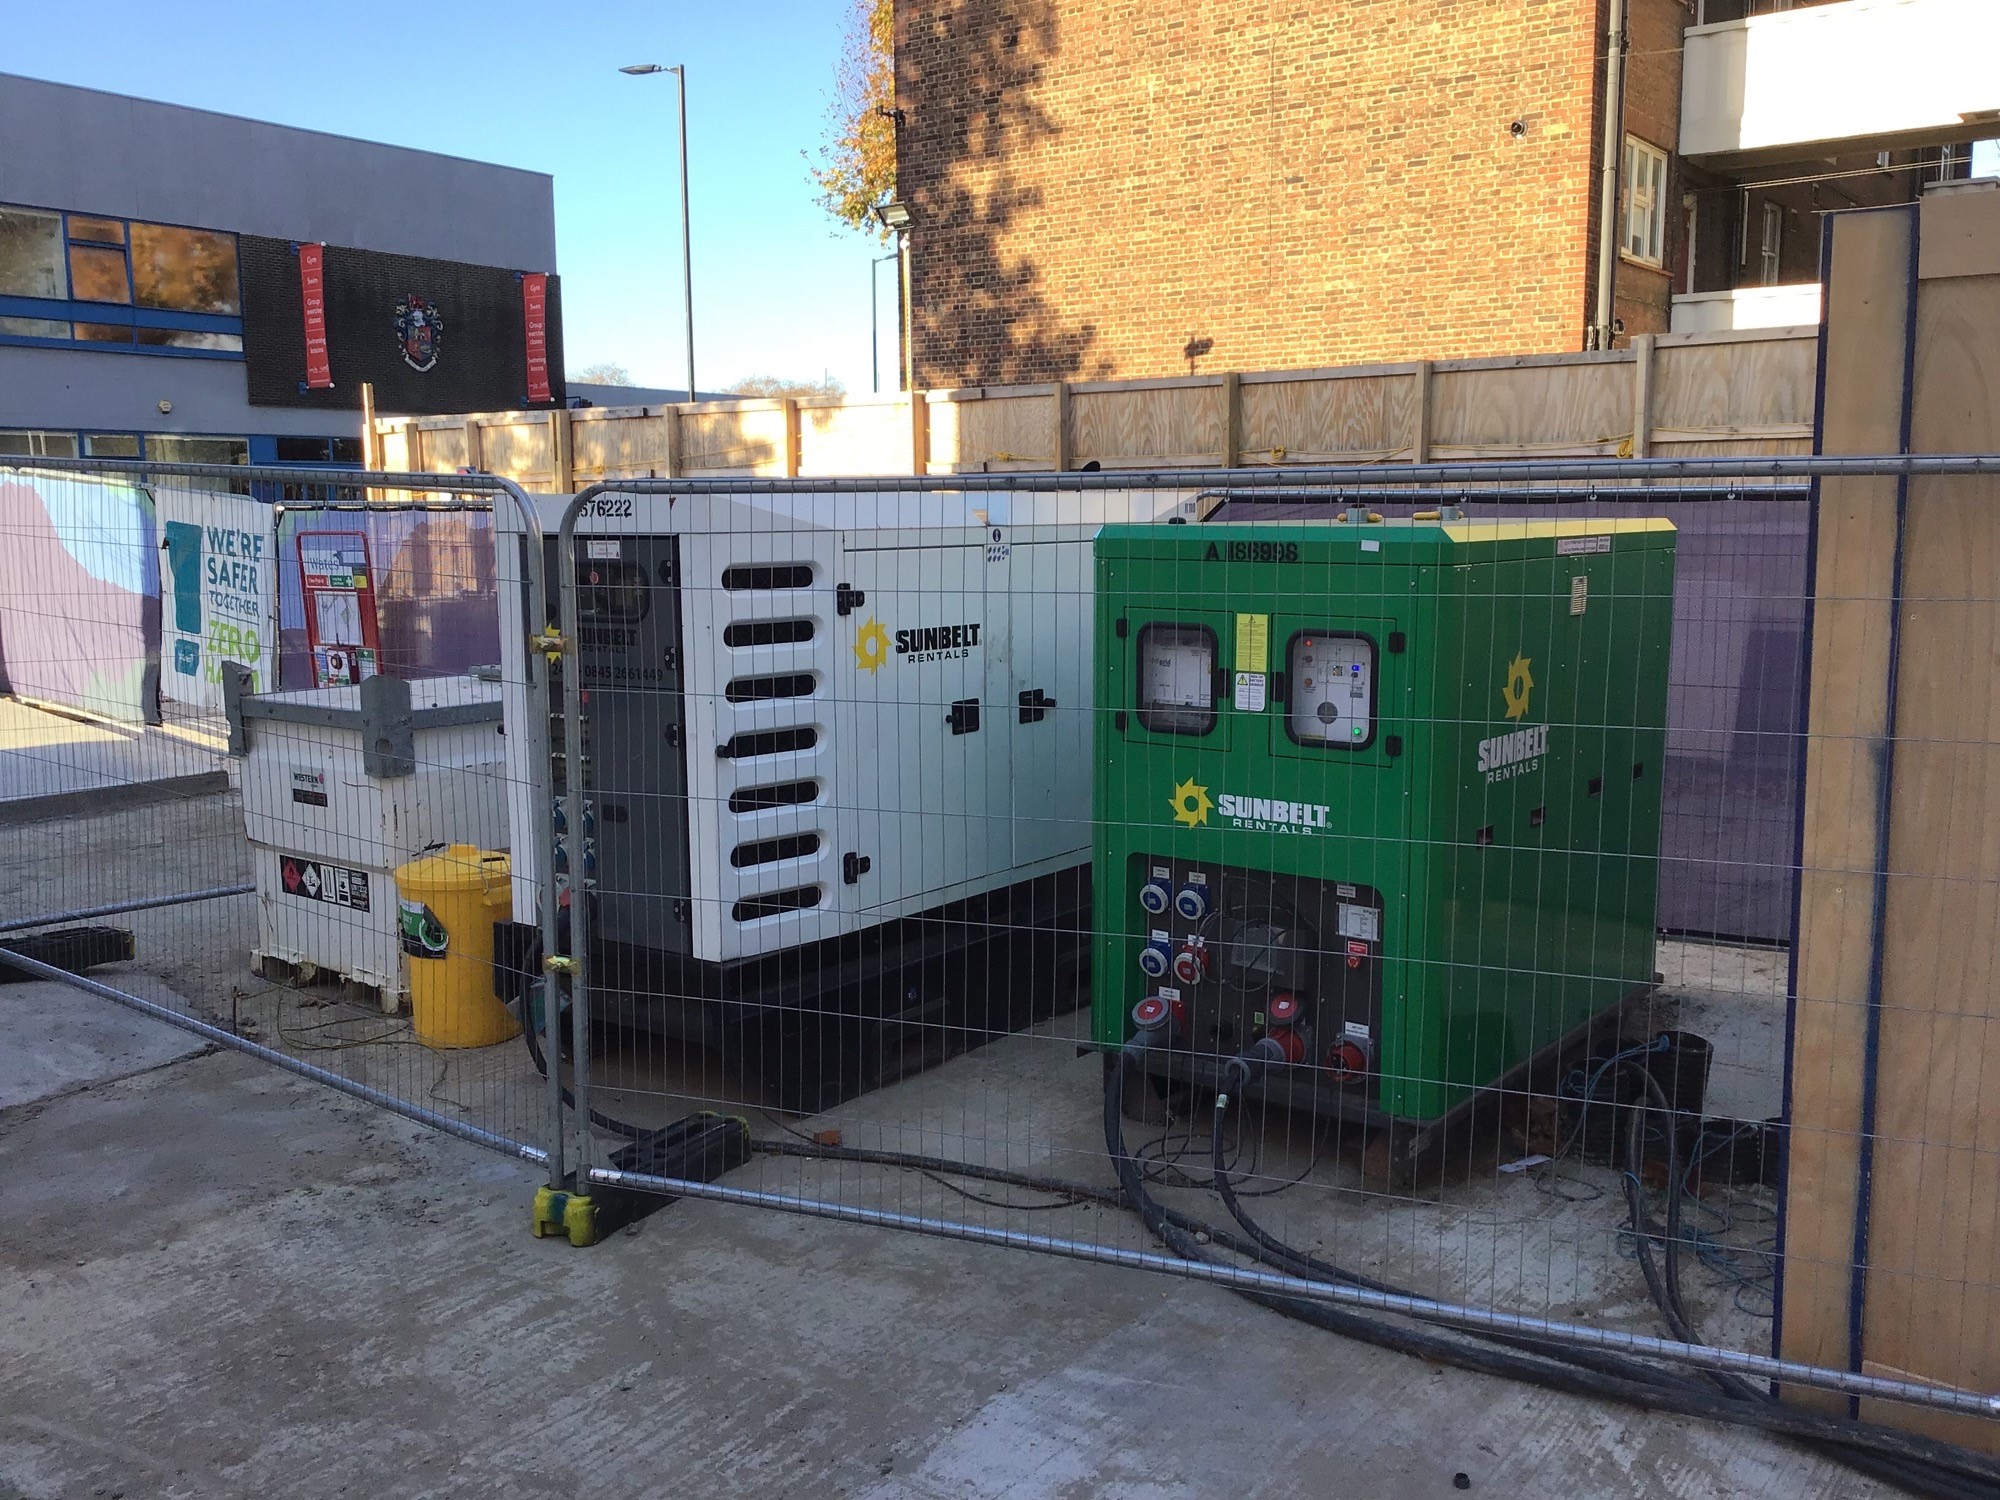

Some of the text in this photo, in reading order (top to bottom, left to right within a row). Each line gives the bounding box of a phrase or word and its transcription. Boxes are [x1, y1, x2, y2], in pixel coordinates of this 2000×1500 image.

[530, 284, 541, 293] Gym
[530, 303, 541, 311] Swim
[529, 321, 543, 330] Group
[207, 525, 264, 563] WE'RE
[1205, 541, 1220, 560] A
[207, 557, 260, 595] SAFER
[208, 590, 260, 617] TOGETHER
[207, 619, 260, 663] ZERO
[895, 624, 980, 654] SUNBELT
[908, 649, 969, 664] RENTALS
[585, 665, 611, 679] 0845
[1478, 725, 1549, 772] SUNBELT
[1487, 758, 1539, 784] RENTALS
[1218, 794, 1330, 828] SUNBELT
[1233, 818, 1312, 836] RENTALS
